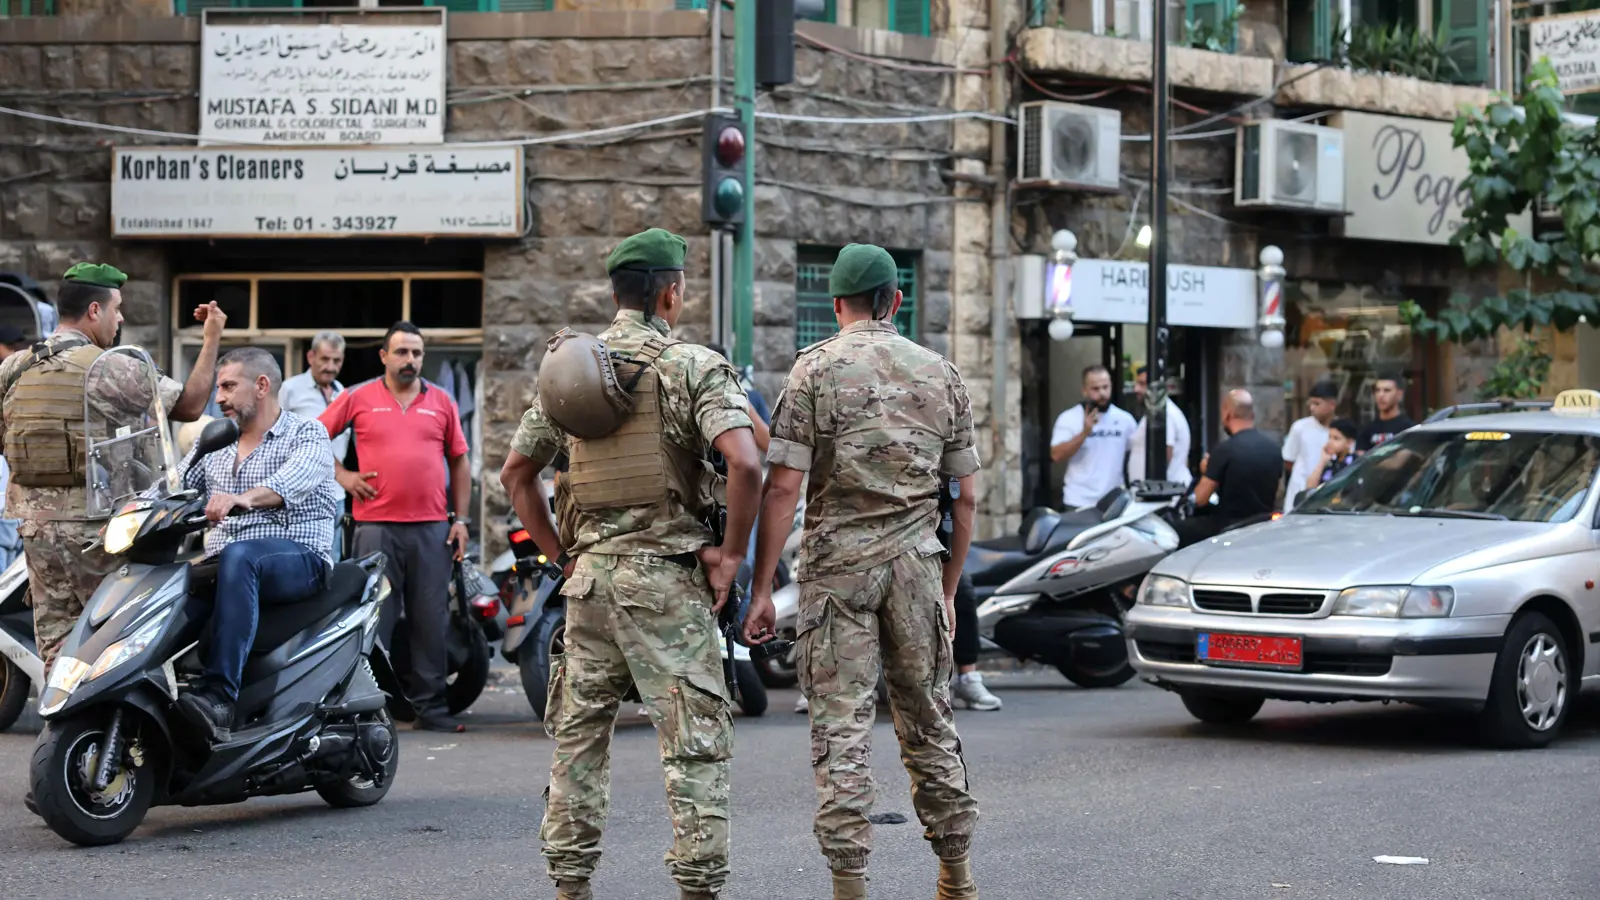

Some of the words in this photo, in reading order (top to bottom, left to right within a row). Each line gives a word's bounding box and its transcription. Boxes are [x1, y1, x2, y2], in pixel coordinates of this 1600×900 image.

[206, 99, 296, 116] MUSTAFA
[330, 99, 397, 116] SIDANI
[214, 118, 273, 130] GENERAL
[290, 118, 363, 130] COLORECTAL
[371, 118, 427, 130] SURGEON
[263, 131, 326, 142] AMERICAN
[339, 131, 382, 142] BOARD
[121, 154, 209, 181] Korban's
[216, 154, 304, 181] Cleaners
[334, 153, 418, 182] قربان
[423, 154, 511, 181] مصبغة
[1372, 124, 1472, 236] Poga
[121, 217, 183, 230] Established
[187, 217, 214, 230] 1947
[254, 216, 287, 231] Tel:
[293, 216, 313, 231] 01
[332, 216, 398, 231] 343927
[1101, 266, 1205, 294] HARUSH
[1561, 394, 1592, 407] TAXI
